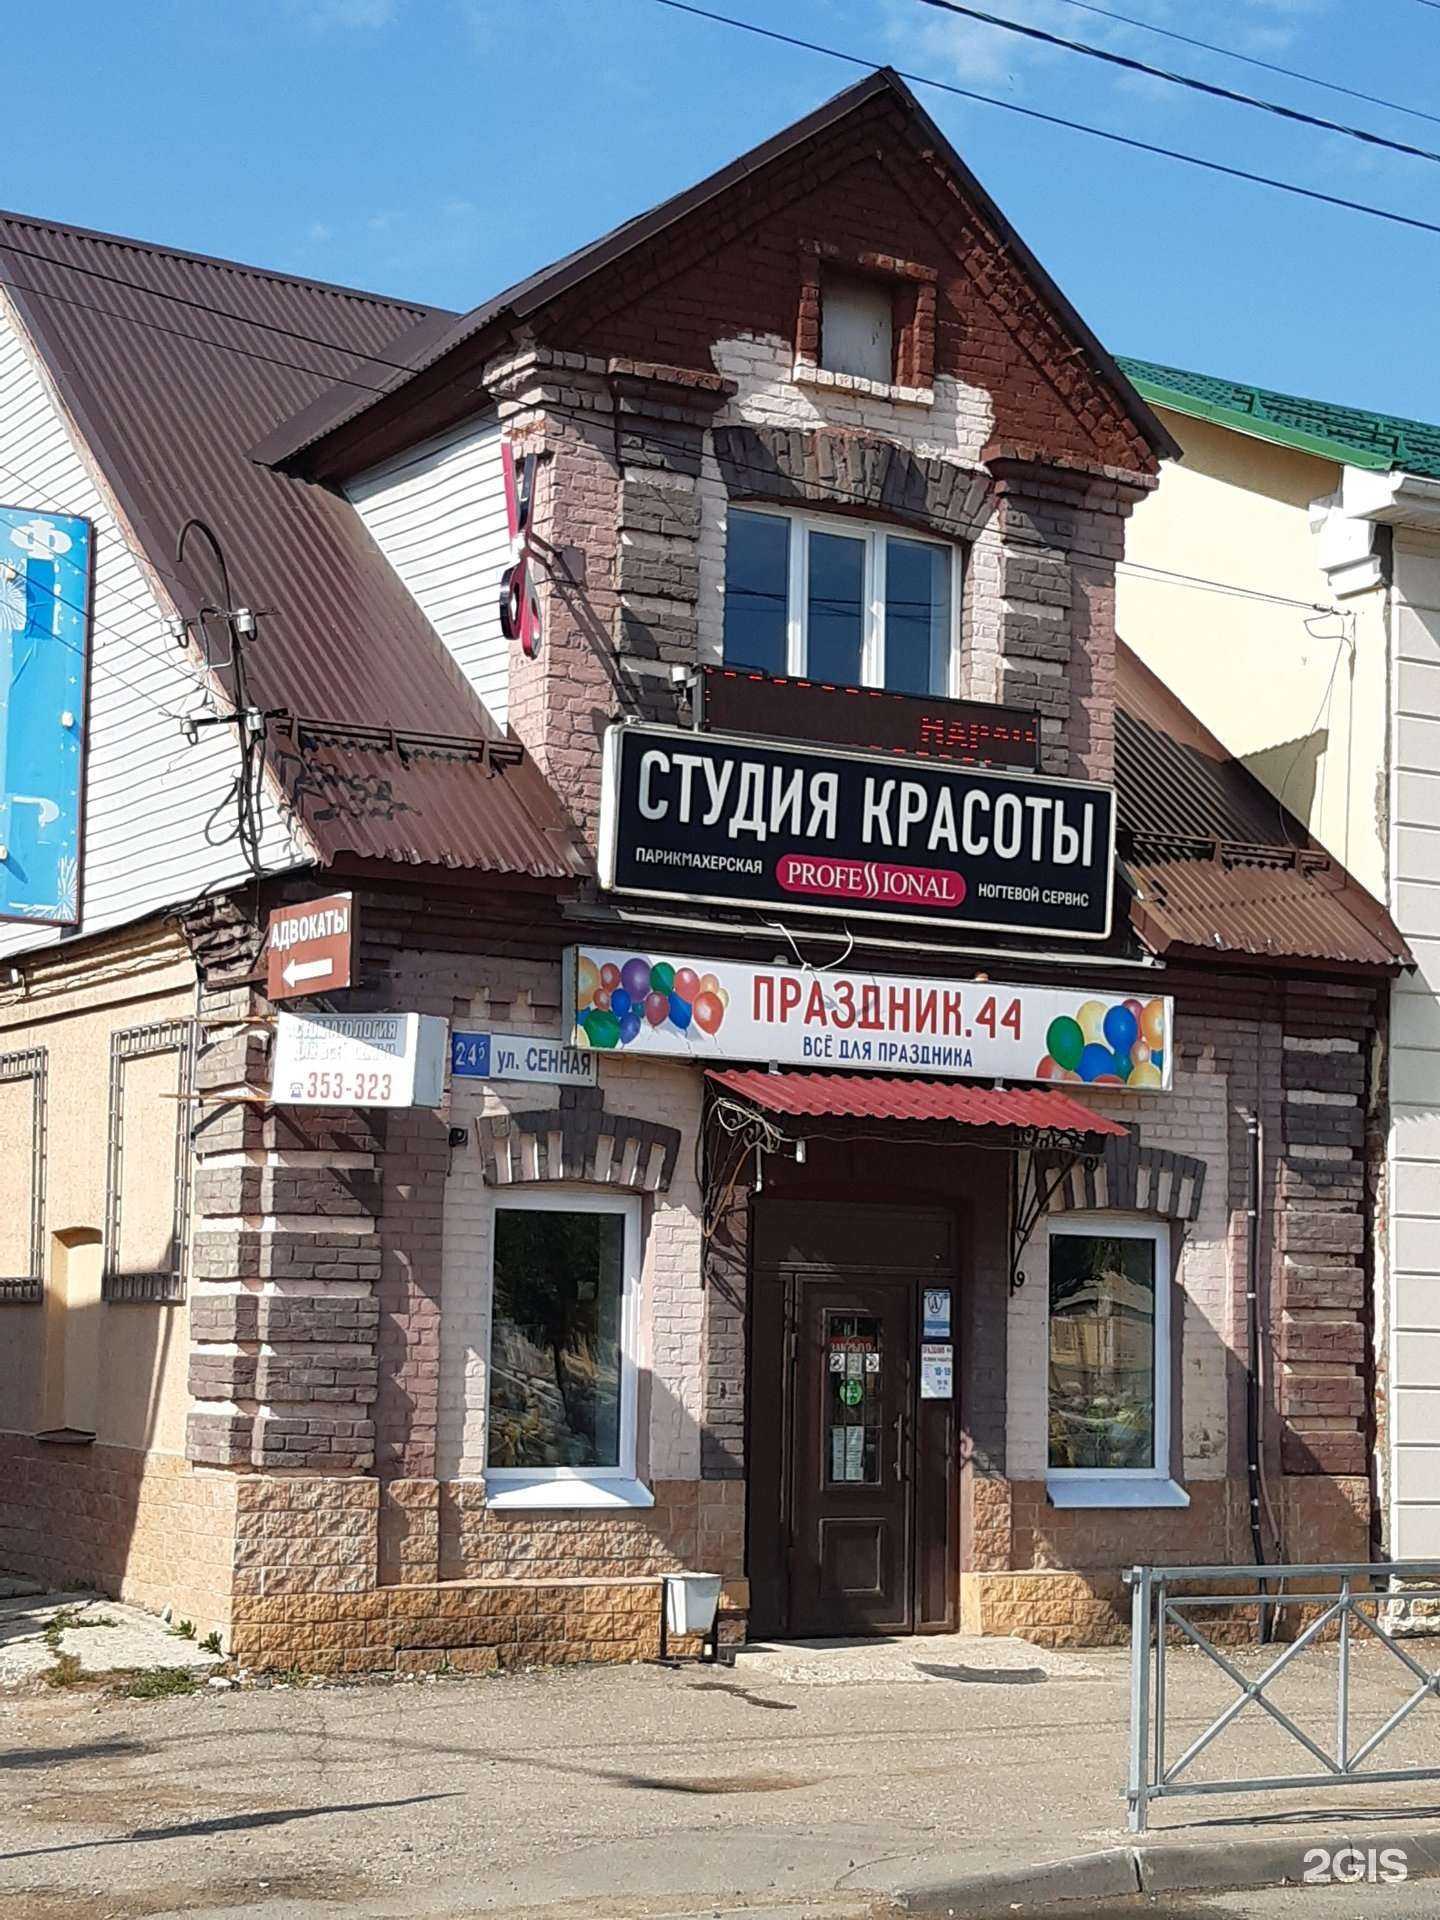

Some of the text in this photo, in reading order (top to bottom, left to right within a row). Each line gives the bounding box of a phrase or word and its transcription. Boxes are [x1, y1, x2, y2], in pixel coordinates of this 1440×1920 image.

[638, 749, 1092, 867] СТУДИЯ КРАСОТЫ
[635, 846, 763, 875] ПАРИКМАХЕРСКАЯ
[786, 861, 956, 901] PROFESSIONAL
[978, 883, 1090, 908] НОГТЕВОЙ СЕРВИС
[270, 907, 349, 952] АДВОКАТЫ
[752, 975, 1022, 1041] ПРАЗДНИК.44
[497, 1047, 592, 1076] ул. СЕННАЯ
[803, 1035, 973, 1067] ВСЁ ДЛЯ ПРАЗДНИКА
[307, 1071, 392, 1101] 353-323
